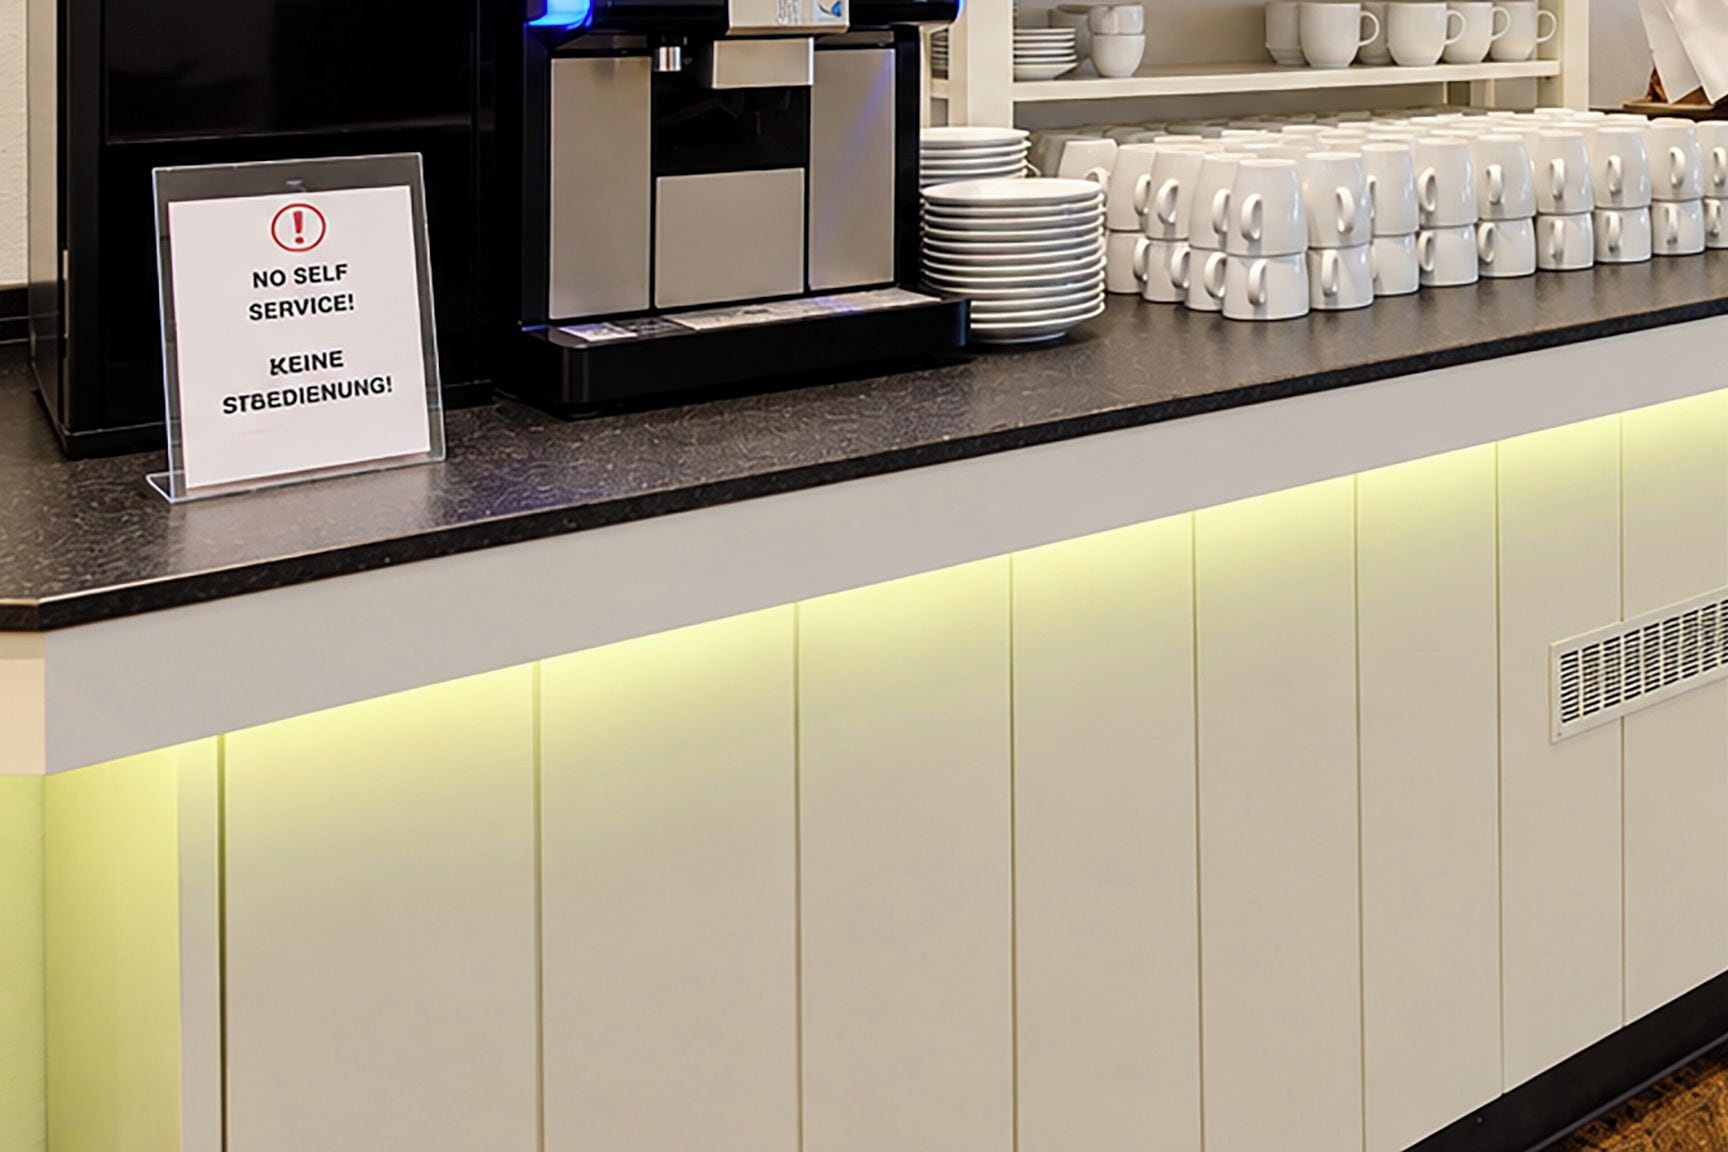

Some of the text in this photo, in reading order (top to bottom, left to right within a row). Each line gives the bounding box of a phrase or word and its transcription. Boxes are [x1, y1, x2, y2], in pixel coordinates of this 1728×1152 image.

[252, 264, 348, 288] NO SELF
[249, 293, 354, 321] SERVICE!
[269, 350, 344, 376] KEINE
